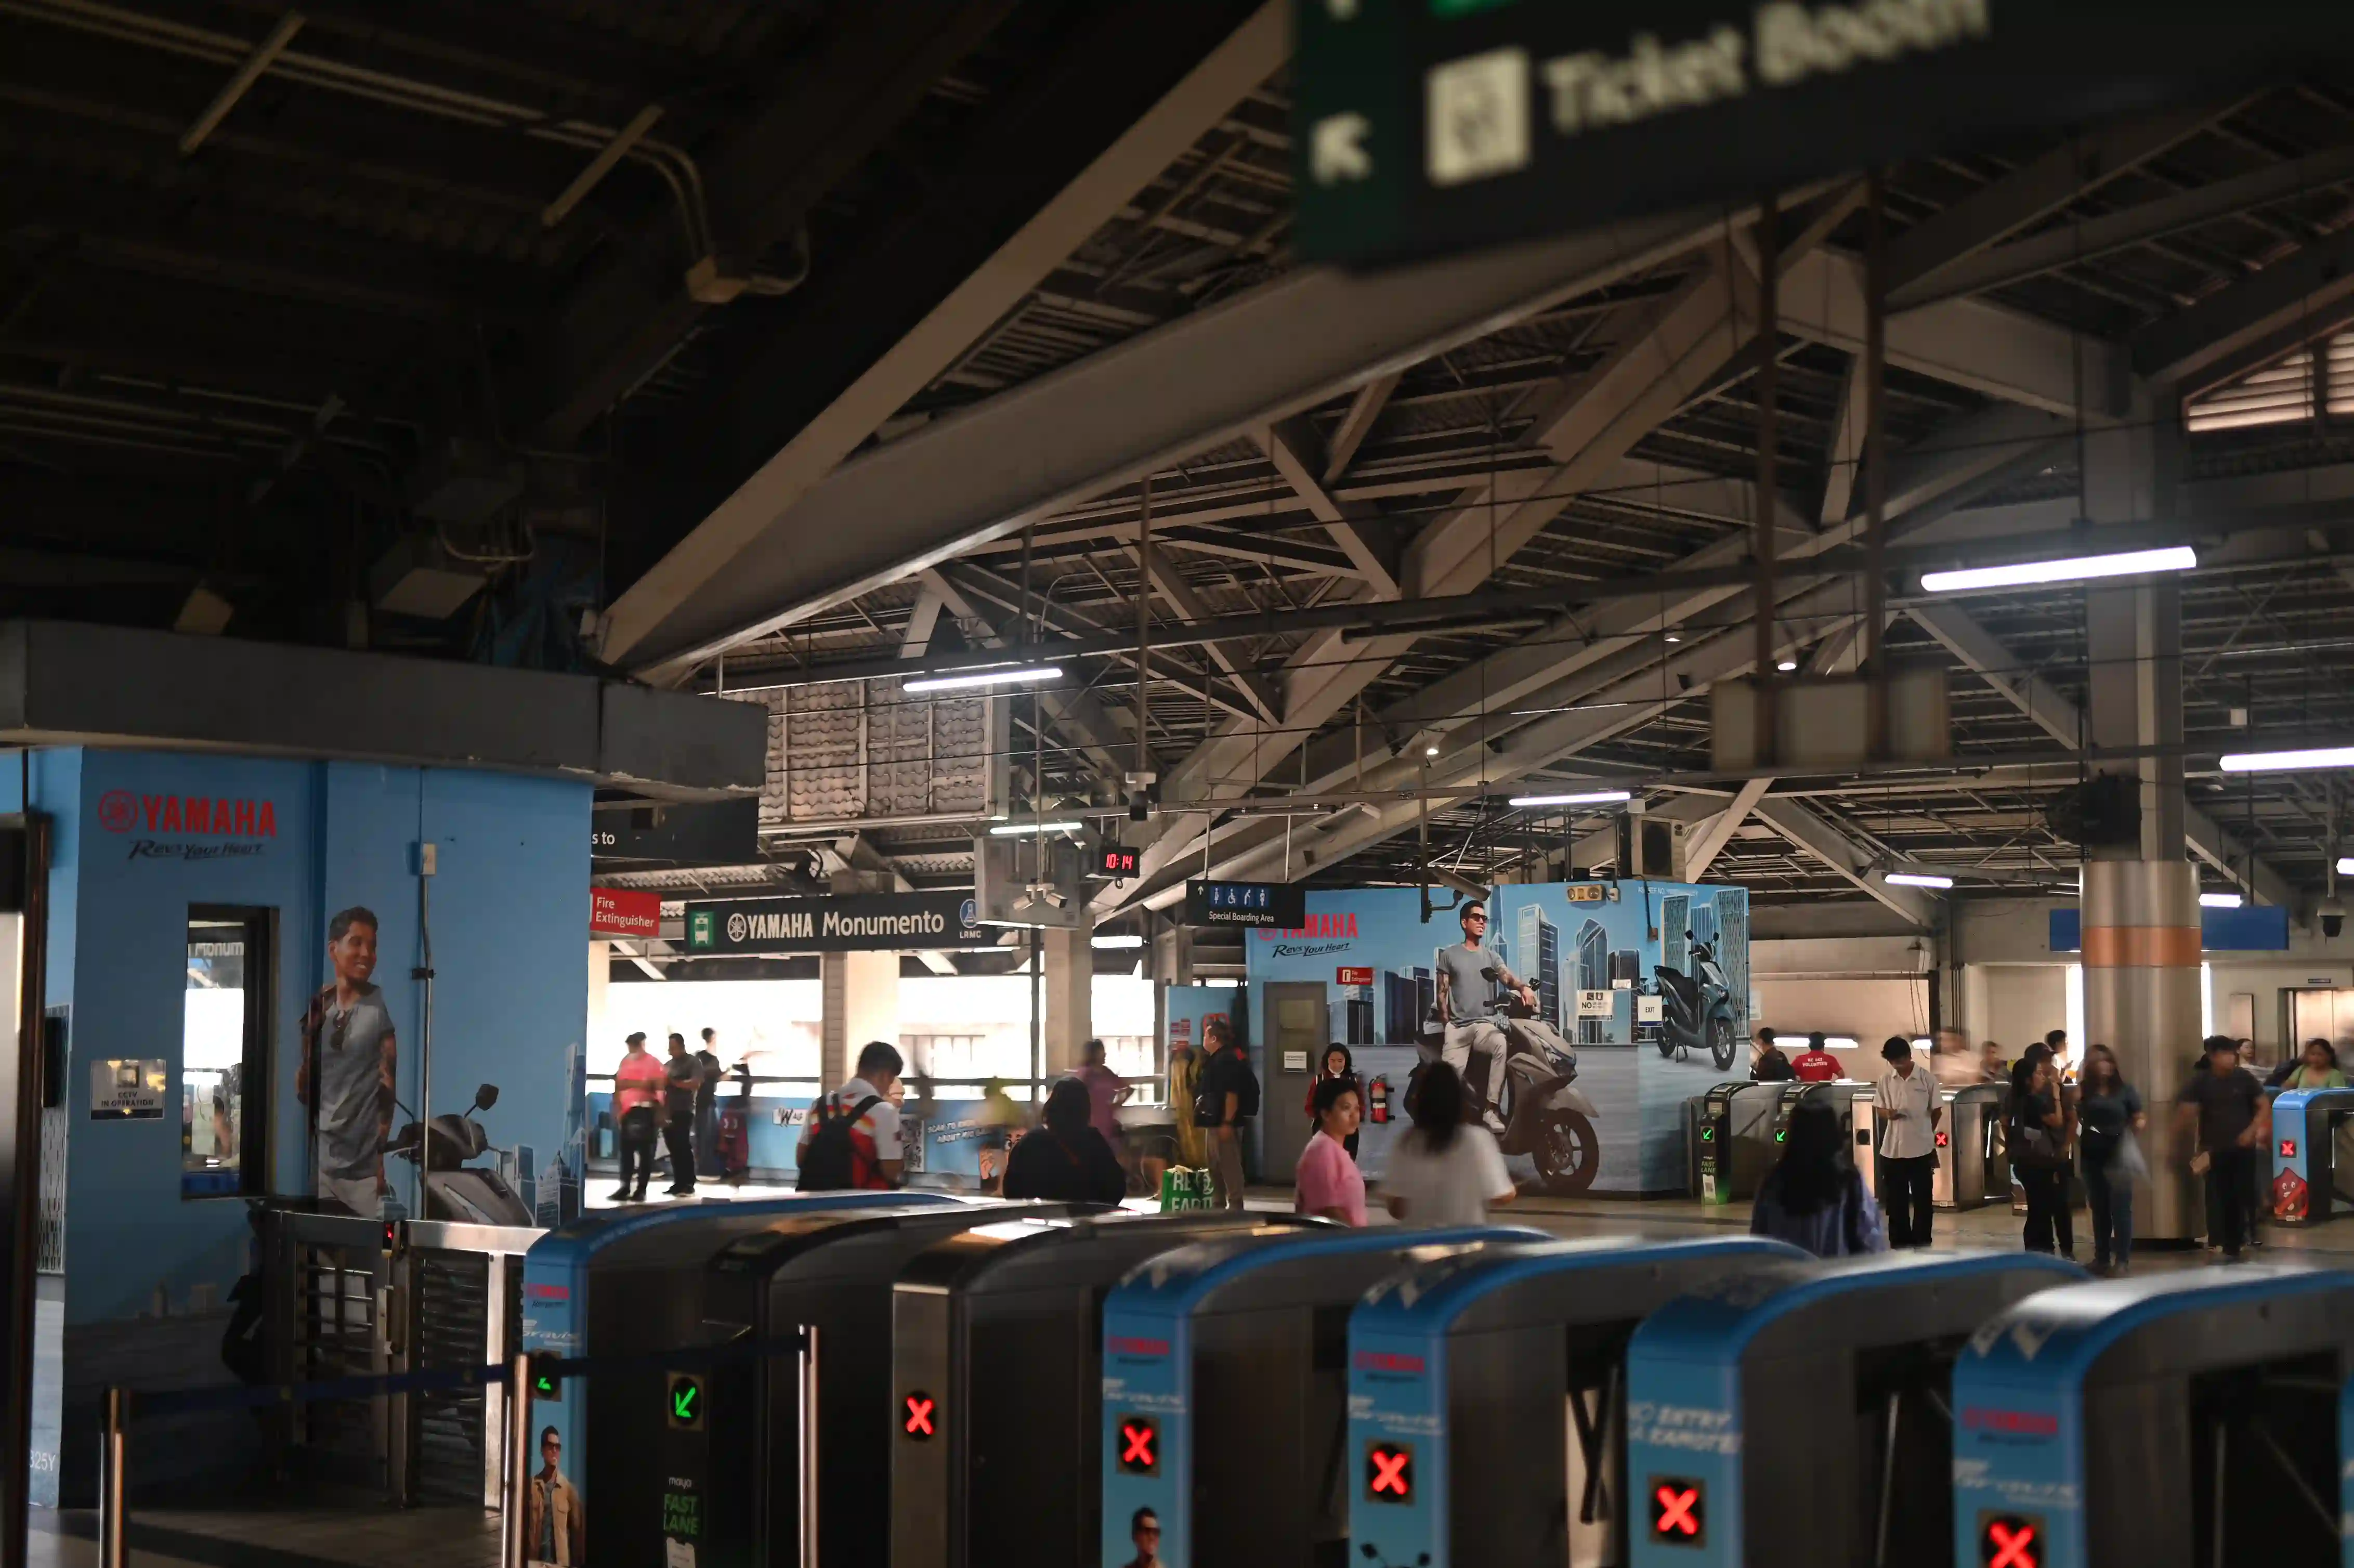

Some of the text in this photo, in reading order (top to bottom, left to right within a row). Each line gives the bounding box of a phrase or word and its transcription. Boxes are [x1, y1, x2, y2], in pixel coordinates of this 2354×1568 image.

[142, 794, 277, 838] YAMAHA
[601, 832, 615, 844] to
[1106, 853, 1133, 869] 10:14
[596, 896, 615, 909] Fire
[596, 911, 655, 928] Extinguisher
[748, 910, 944, 939] YAMAHA Monumento
[1209, 911, 1274, 924] Special Boarding Area
[960, 930, 982, 939] LRMC
[1272, 943, 1351, 958] Revs Your Heart
[669, 1476, 692, 1489] maya
[664, 1494, 698, 1514] FAST
[663, 1512, 699, 1535] LANE
